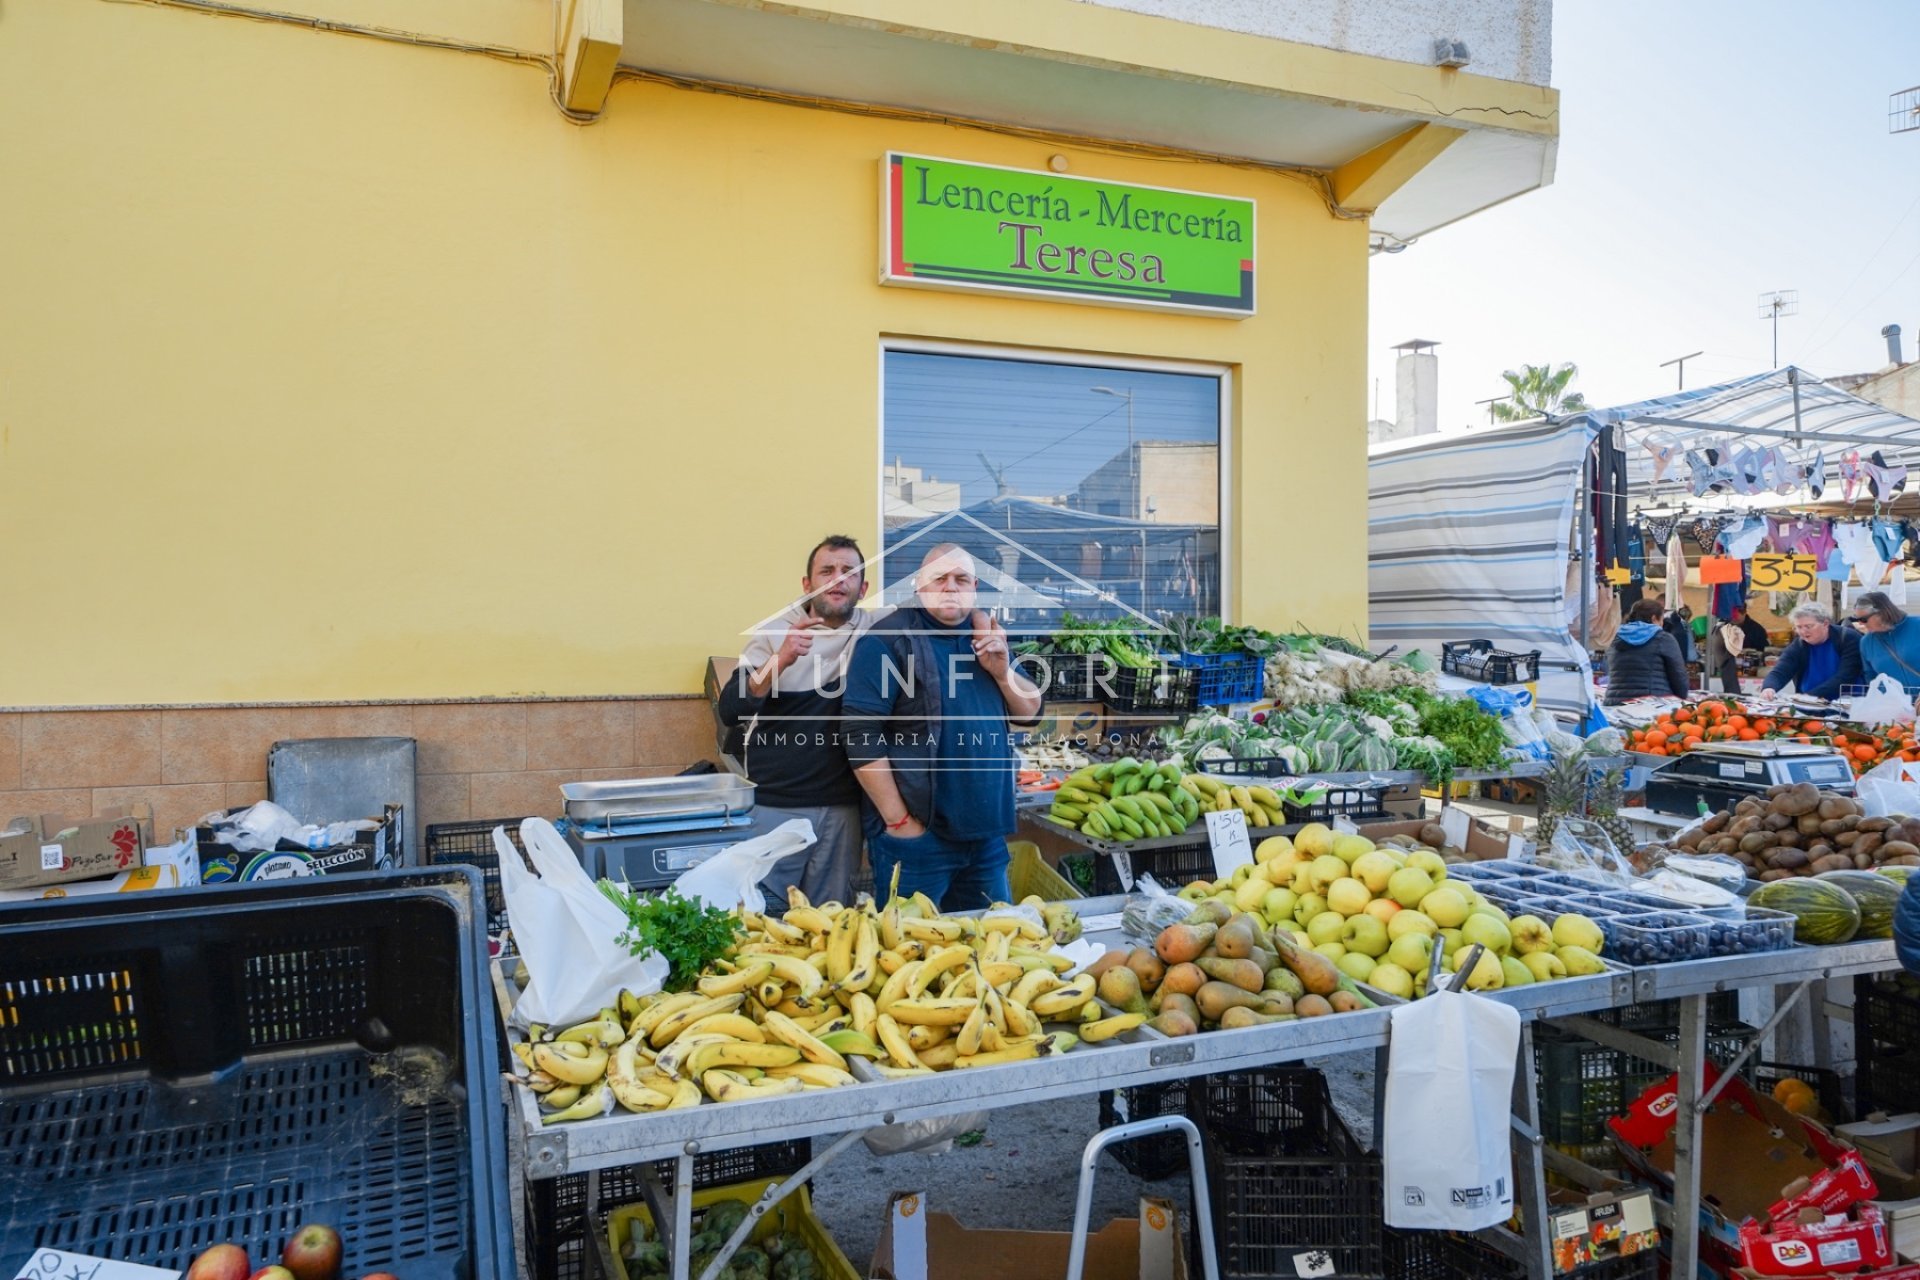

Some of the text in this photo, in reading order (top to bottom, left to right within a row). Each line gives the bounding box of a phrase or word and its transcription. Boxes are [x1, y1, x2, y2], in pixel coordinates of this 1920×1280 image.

[914, 166, 1071, 223] Lencería
[1096, 189, 1244, 243] Mercería
[997, 220, 1167, 284] Teresa
[306, 848, 366, 872] SELECCIÓN
[1778, 1243, 1806, 1258] Dole
